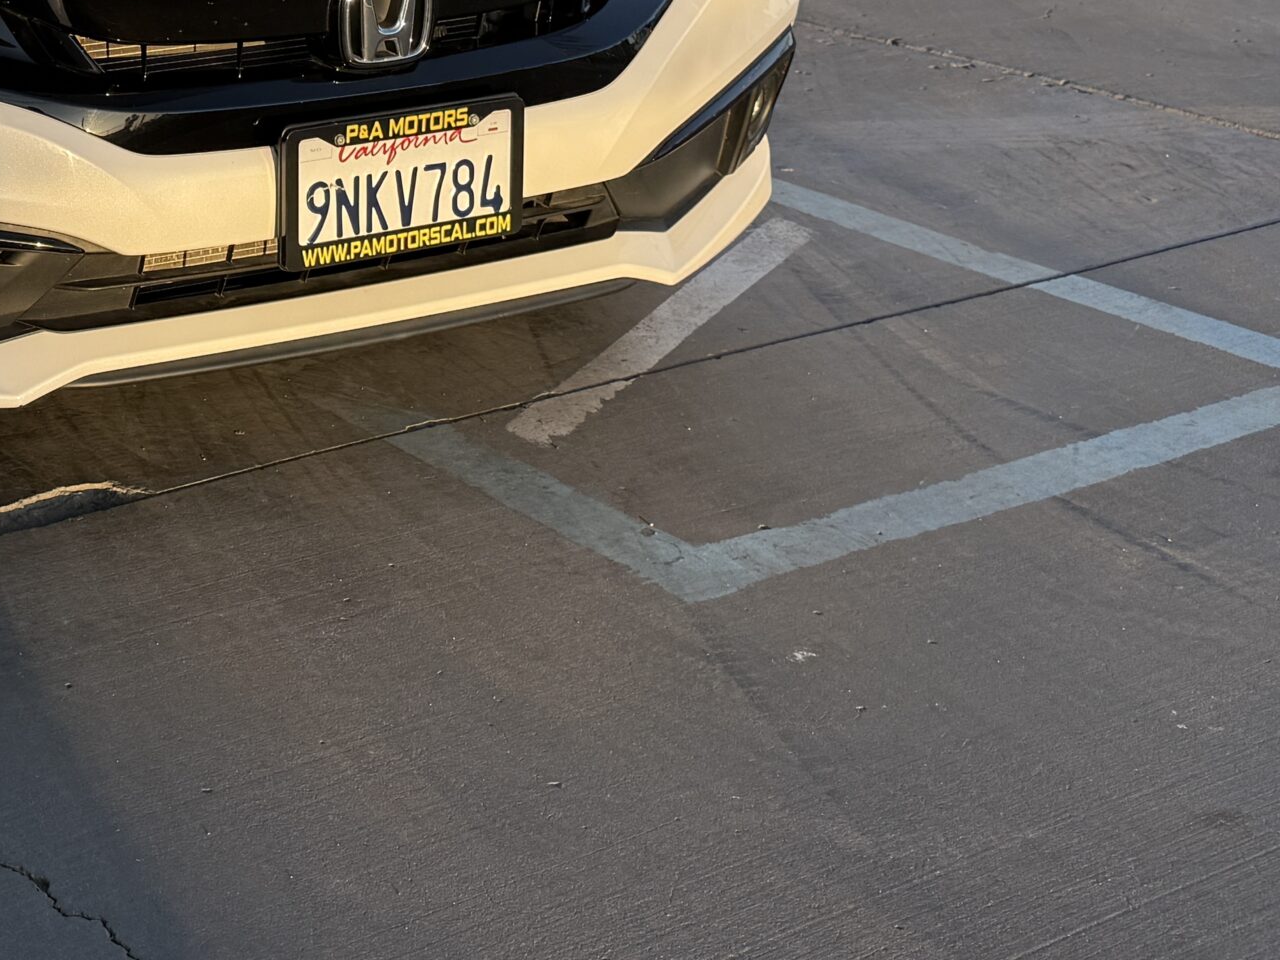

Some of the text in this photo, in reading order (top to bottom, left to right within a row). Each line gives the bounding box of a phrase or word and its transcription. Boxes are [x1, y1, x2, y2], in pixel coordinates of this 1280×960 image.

[337, 127, 478, 165] California
[344, 107, 469, 144] P&A MOTORS
[306, 154, 504, 246] 9NKV784
[301, 214, 511, 268] WWW.PAMOTORSCAL.COM
